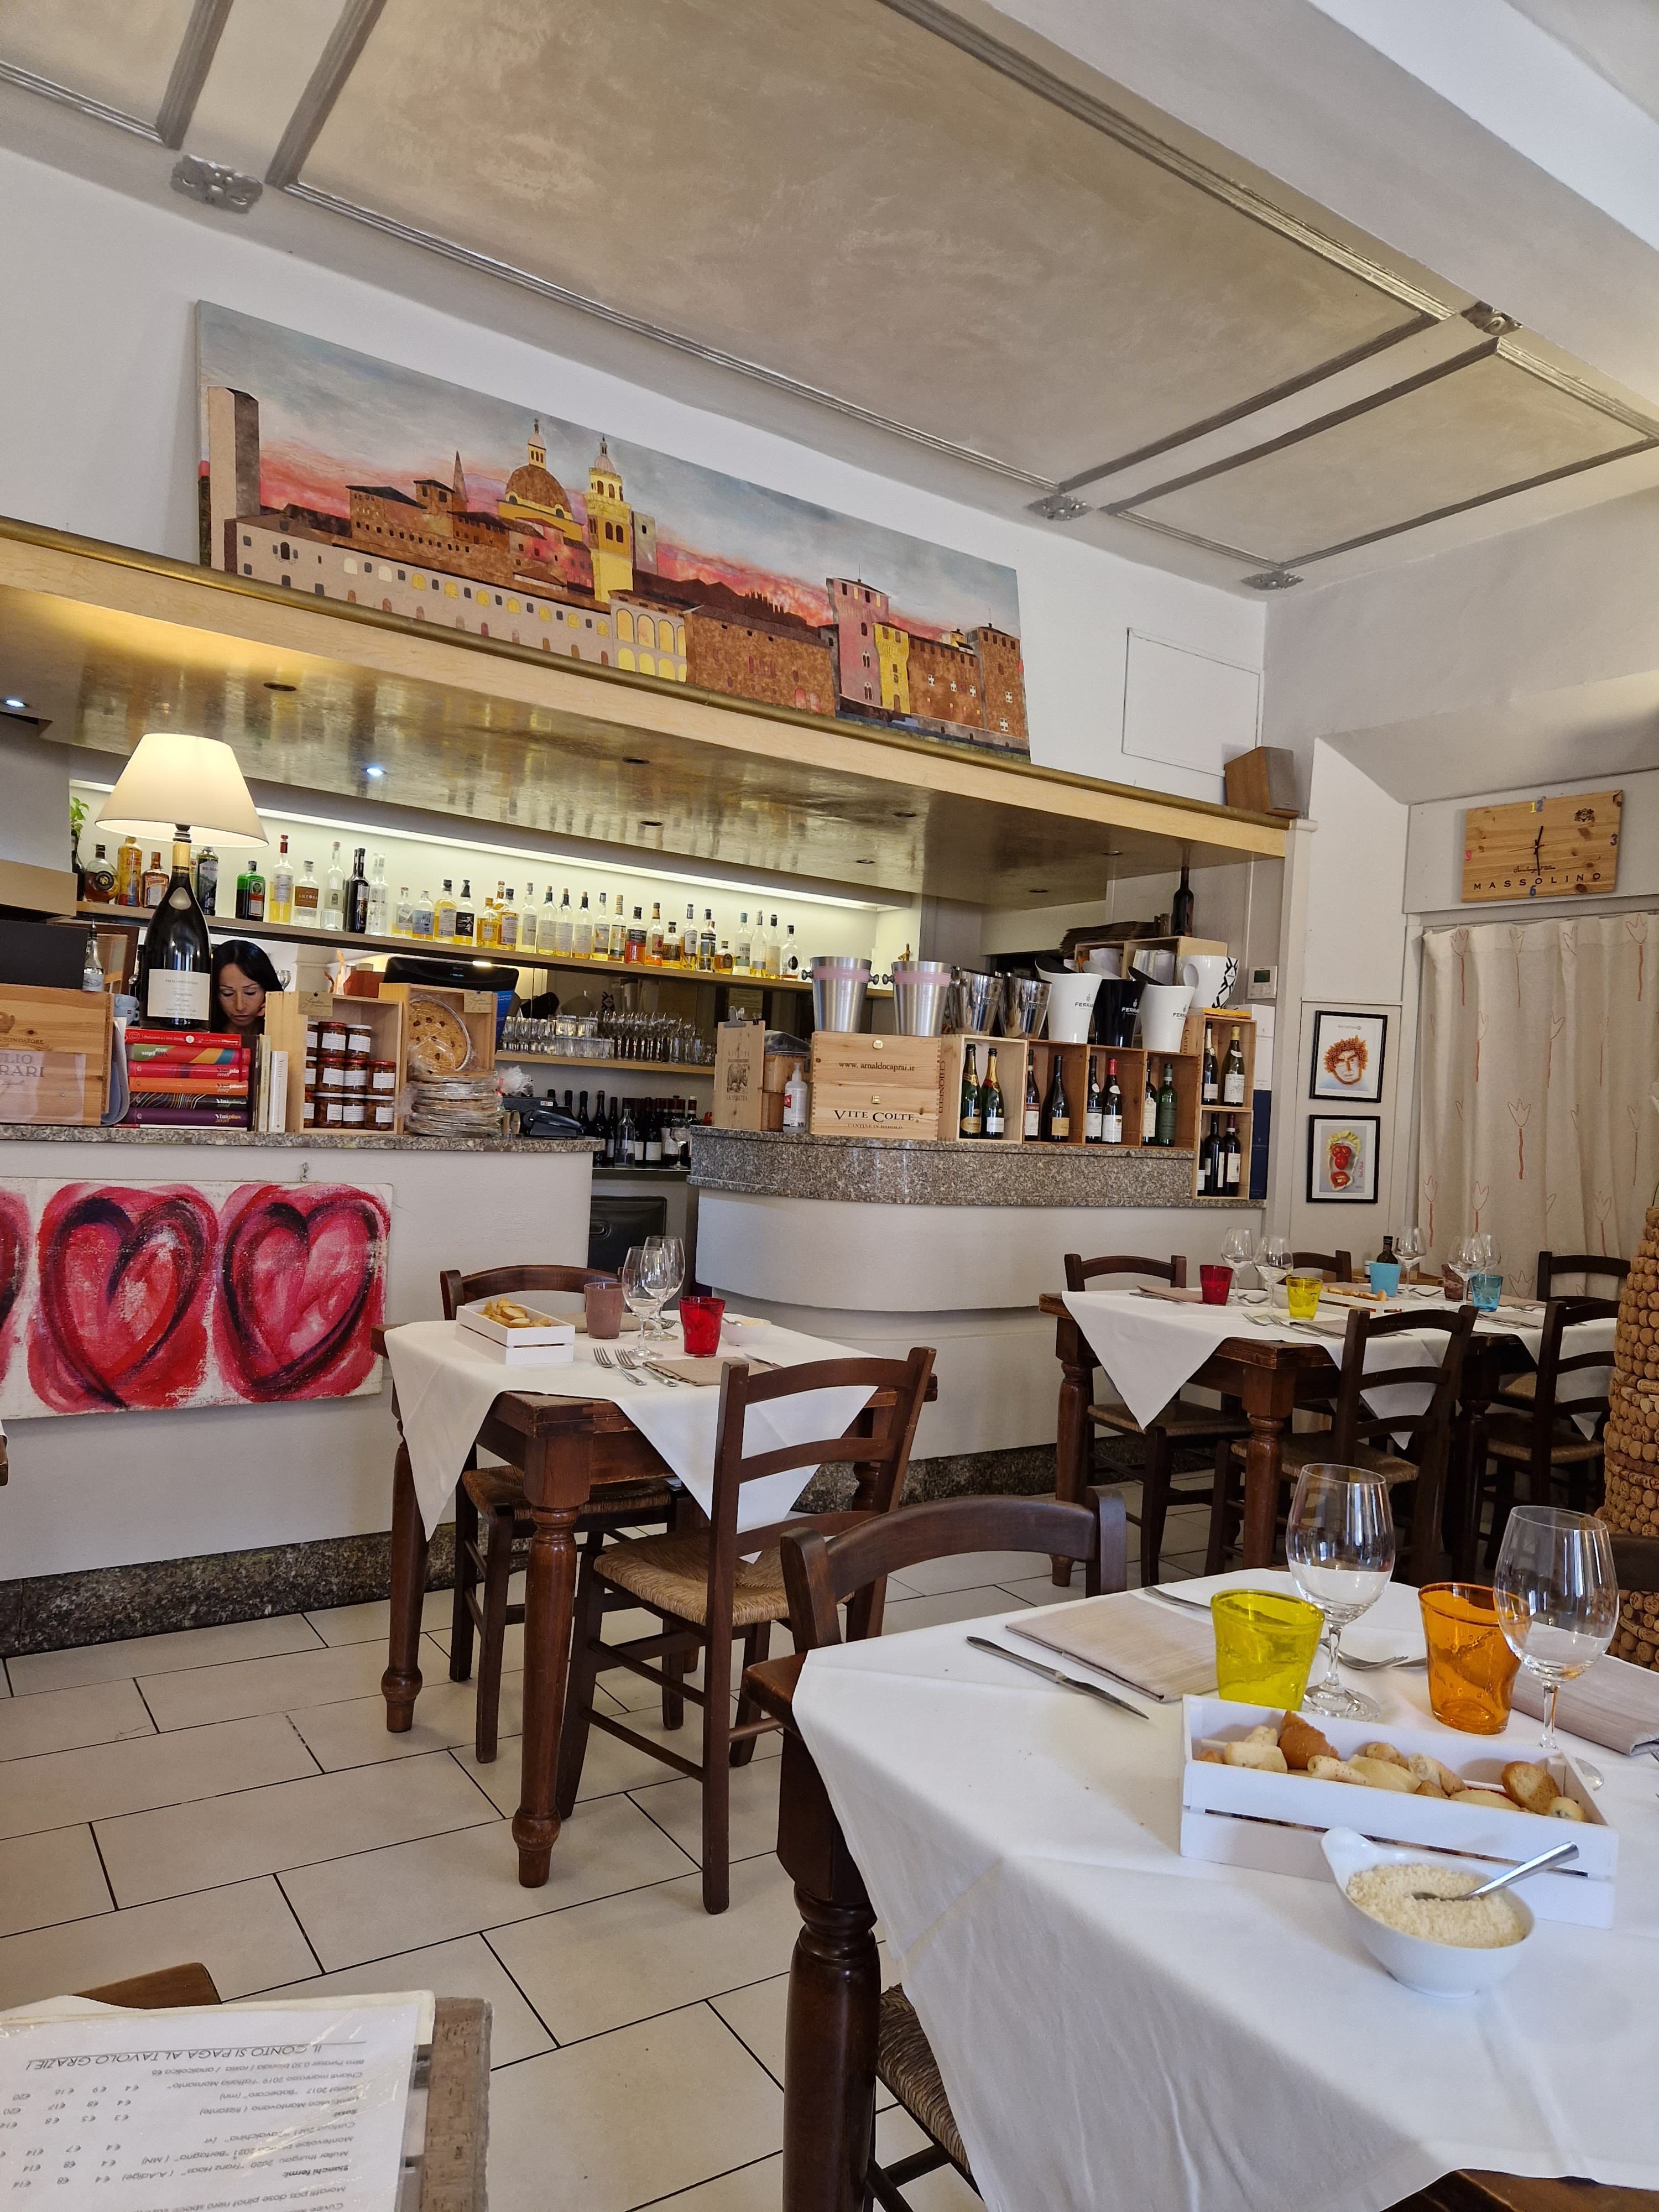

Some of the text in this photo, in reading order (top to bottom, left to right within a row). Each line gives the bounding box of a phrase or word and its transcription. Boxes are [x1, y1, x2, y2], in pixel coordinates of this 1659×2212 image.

[1610, 833, 1618, 846] 3
[1473, 872, 1601, 890] MASSOLINO
[1530, 885, 1537, 896] 6
[860, 1062, 915, 1072] arnaldocaprai.it
[834, 1110, 914, 1123] VITE COLTE
[188, 2049, 232, 2059] PAGA
[234, 2048, 247, 2058] SI
[251, 2044, 307, 2057] CONTO
[312, 2046, 322, 2054] IL
[96, 2052, 159, 2064] TAVOLO
[164, 2051, 183, 2061] AL
[34, 2057, 91, 2070] GRAZIE
[252, 2103, 306, 2111] Mantovano
[232, 2196, 260, 2208] pinot
[262, 2194, 287, 2203] dose
